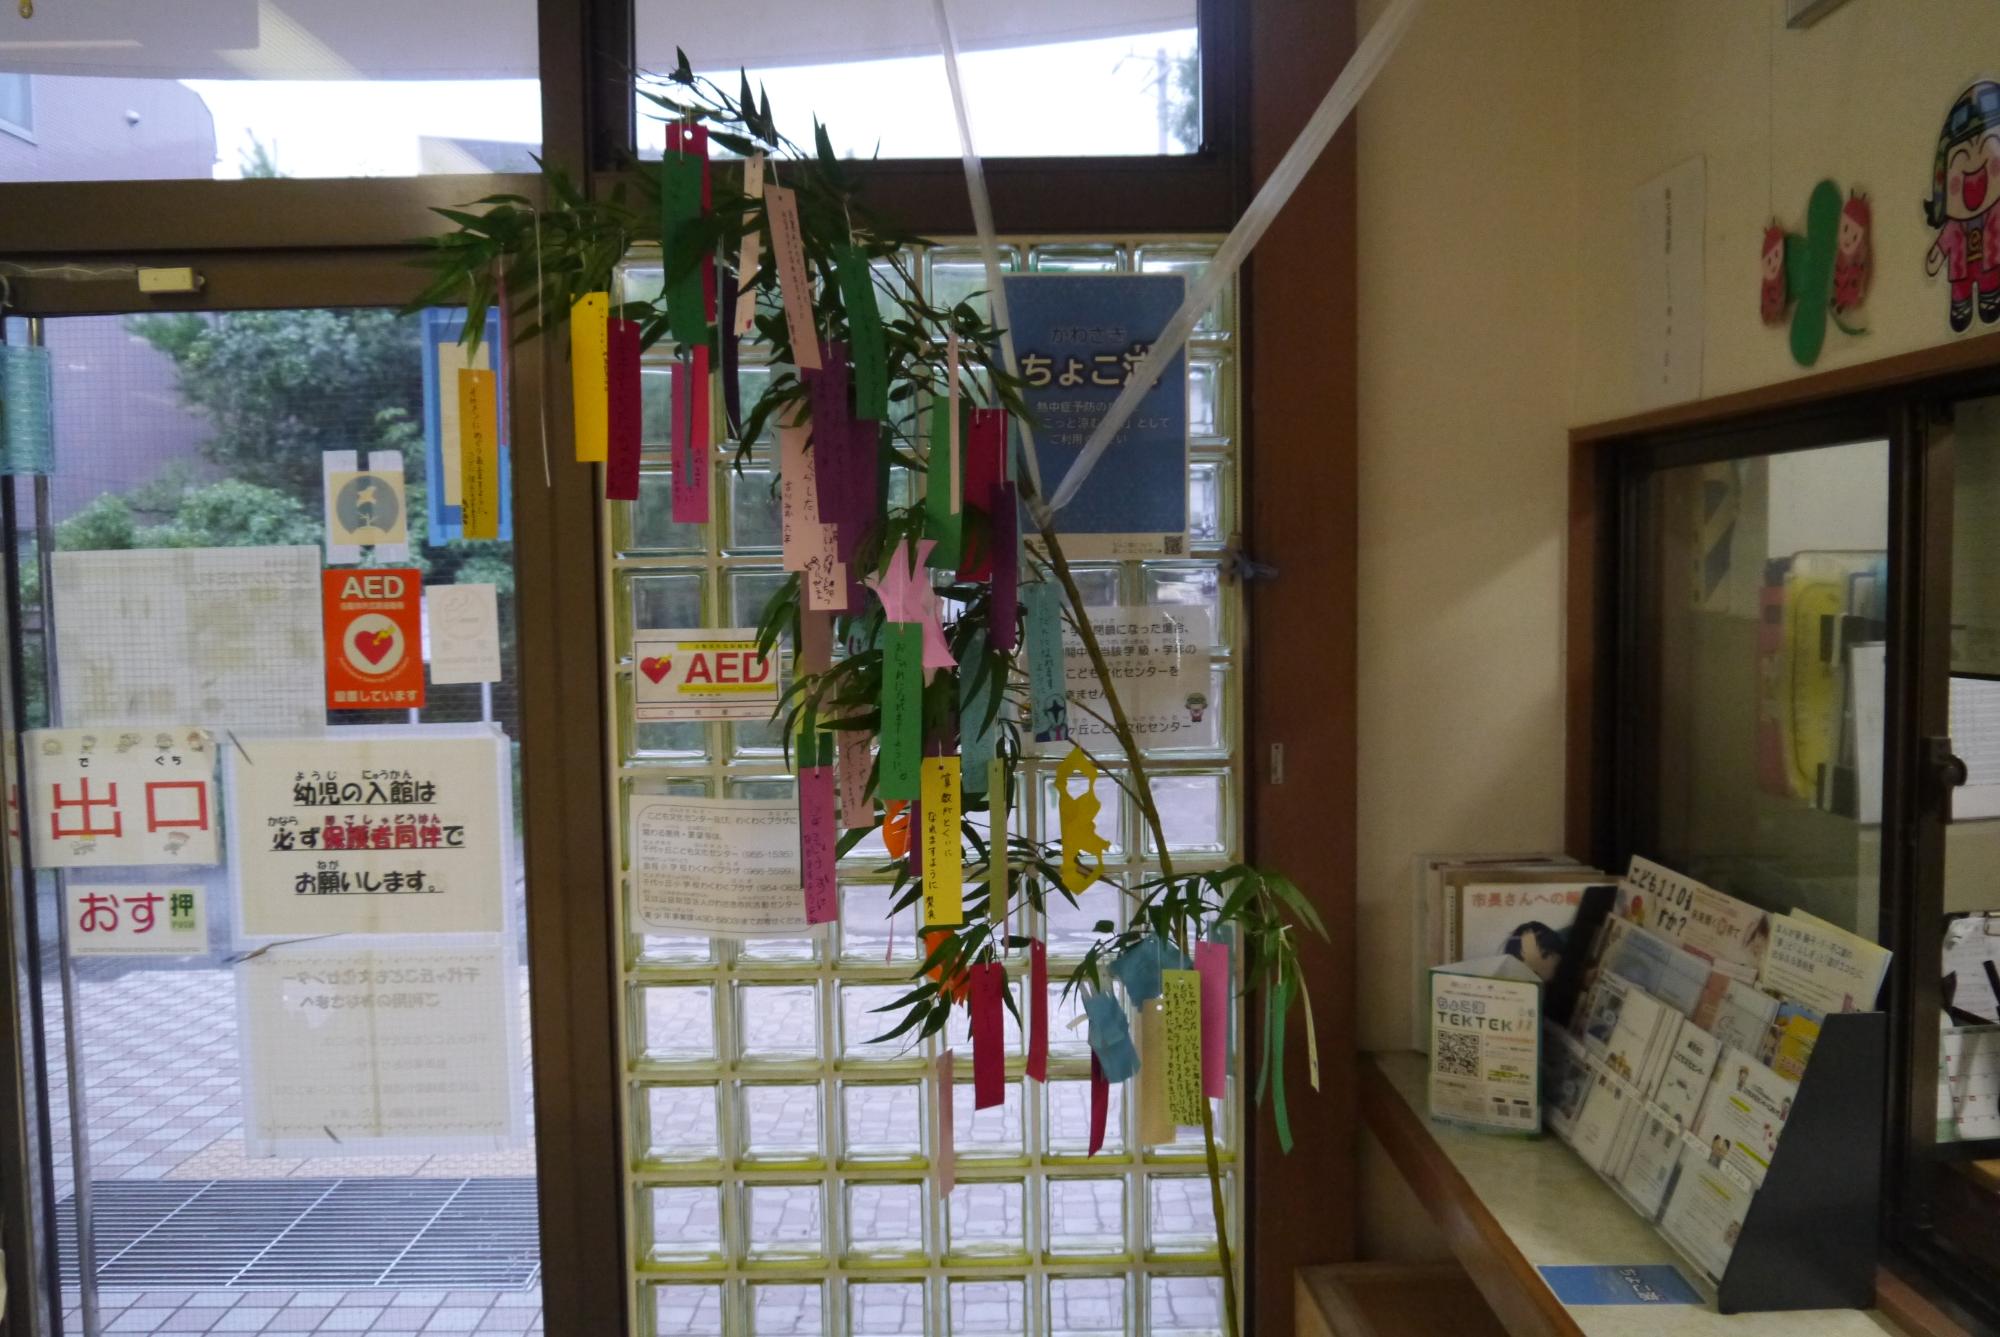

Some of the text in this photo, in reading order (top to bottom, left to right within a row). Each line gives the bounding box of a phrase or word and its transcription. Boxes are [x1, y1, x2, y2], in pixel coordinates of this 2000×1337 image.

[341, 575, 405, 599] AED
[684, 652, 770, 684] AED
[1066, 666, 1179, 680] こども化センターを
[78, 755, 182, 768] で ぐち
[294, 771, 337, 781] ようじ
[293, 780, 436, 805] 幼児の入館は
[51, 776, 209, 840] 出口
[267, 815, 298, 826] かなら
[273, 824, 465, 850] 必ず保護者同伴で
[295, 869, 435, 894] お願いします。
[79, 892, 194, 934] おす 押
[1437, 1011, 1513, 1032] TEKTEK
